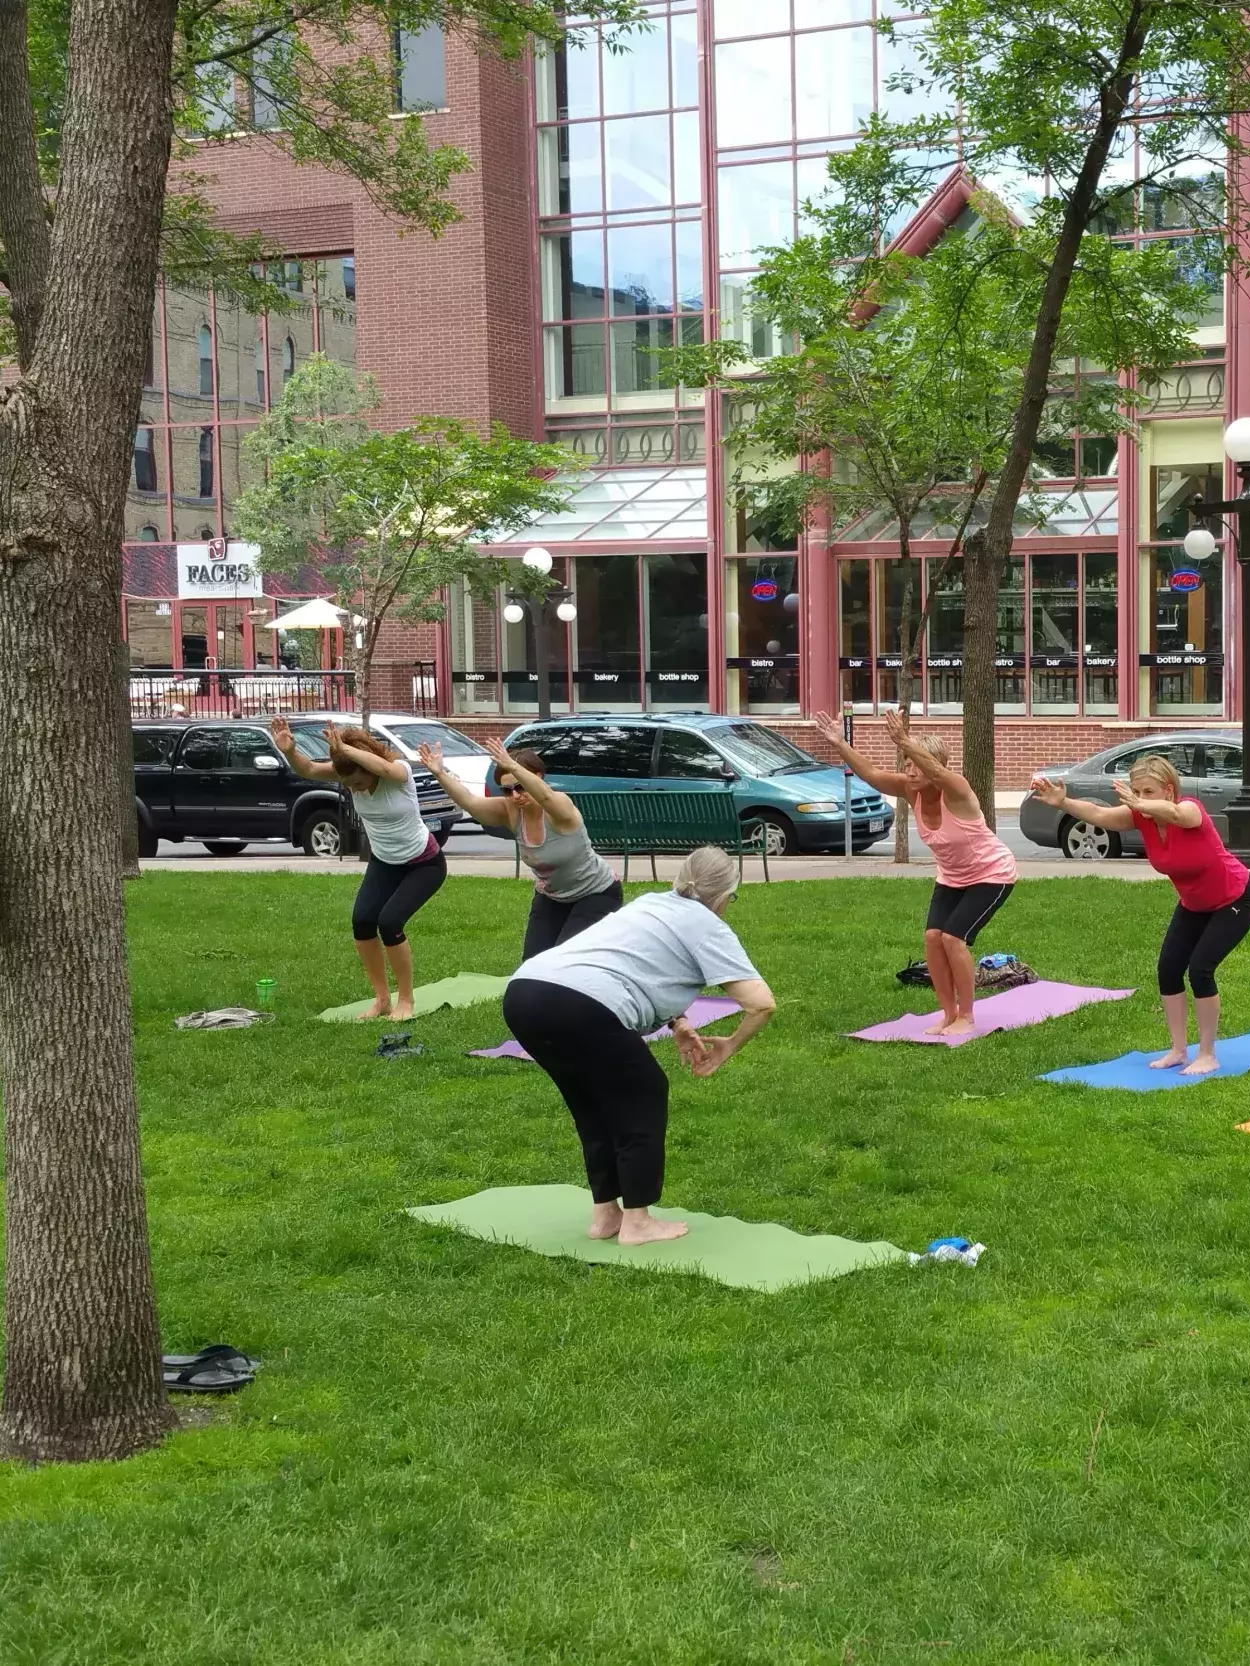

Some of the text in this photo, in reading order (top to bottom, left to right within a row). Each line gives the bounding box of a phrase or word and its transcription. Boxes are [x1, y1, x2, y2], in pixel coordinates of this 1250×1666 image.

[186, 563, 250, 583] FACES
[1173, 574, 1199, 587] OPEN
[753, 585, 776, 597] OPEN
[751, 659, 774, 667] bistro
[849, 659, 863, 667] bar
[952, 658, 962, 666] sh
[1046, 658, 1061, 666] bar
[1086, 658, 1116, 667] bakery
[1156, 655, 1206, 665] bottle shop
[465, 673, 485, 681] bistro
[529, 673, 538, 681] ba
[594, 673, 619, 682] bakery
[659, 673, 699, 682] bottle shop
